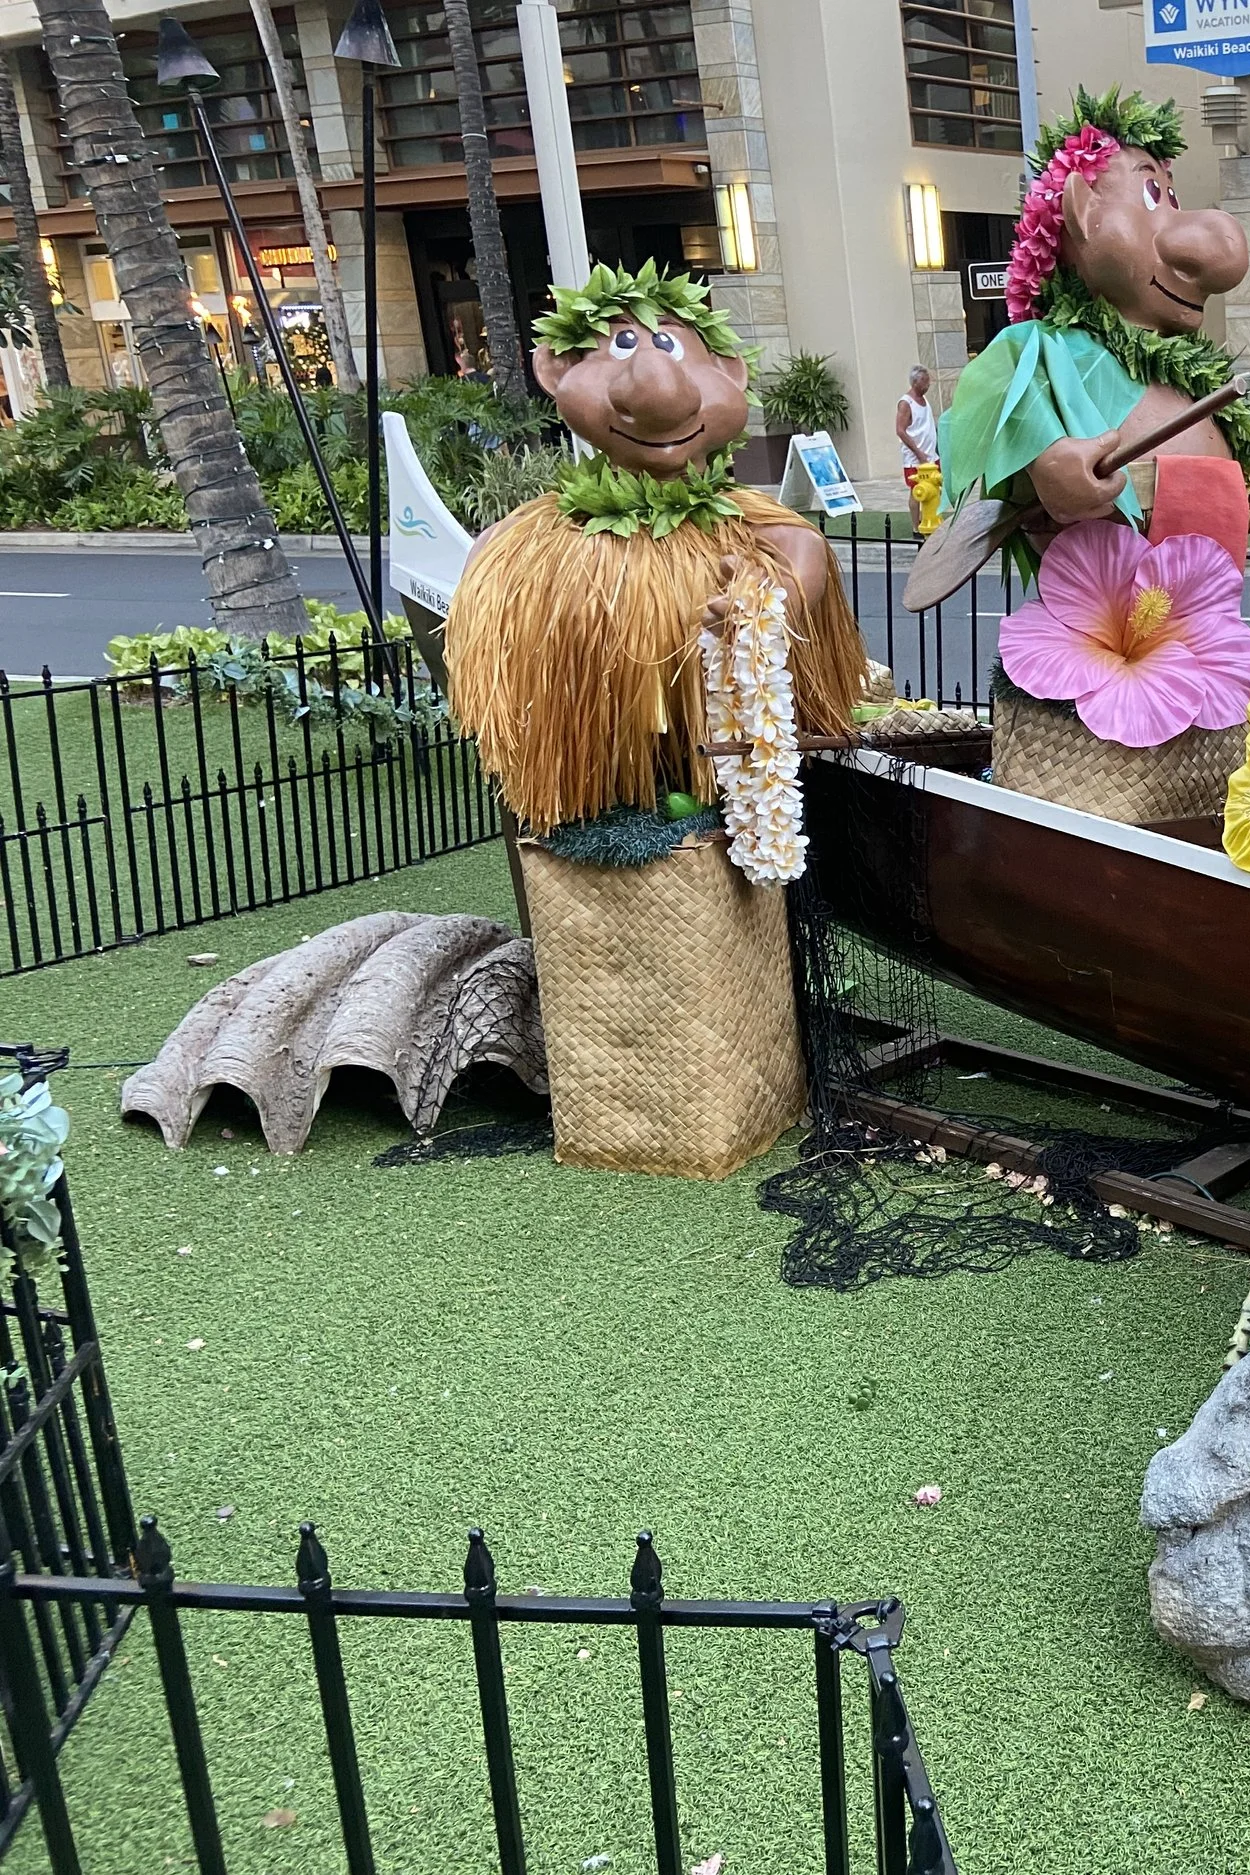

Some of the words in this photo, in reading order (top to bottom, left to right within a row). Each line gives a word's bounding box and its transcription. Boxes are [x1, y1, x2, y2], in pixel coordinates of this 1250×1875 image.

[1196, 14, 1250, 29] VACATION
[1173, 42, 1219, 60] Waikiki
[980, 273, 1005, 288] ONE
[410, 578, 436, 608] Waikiki
